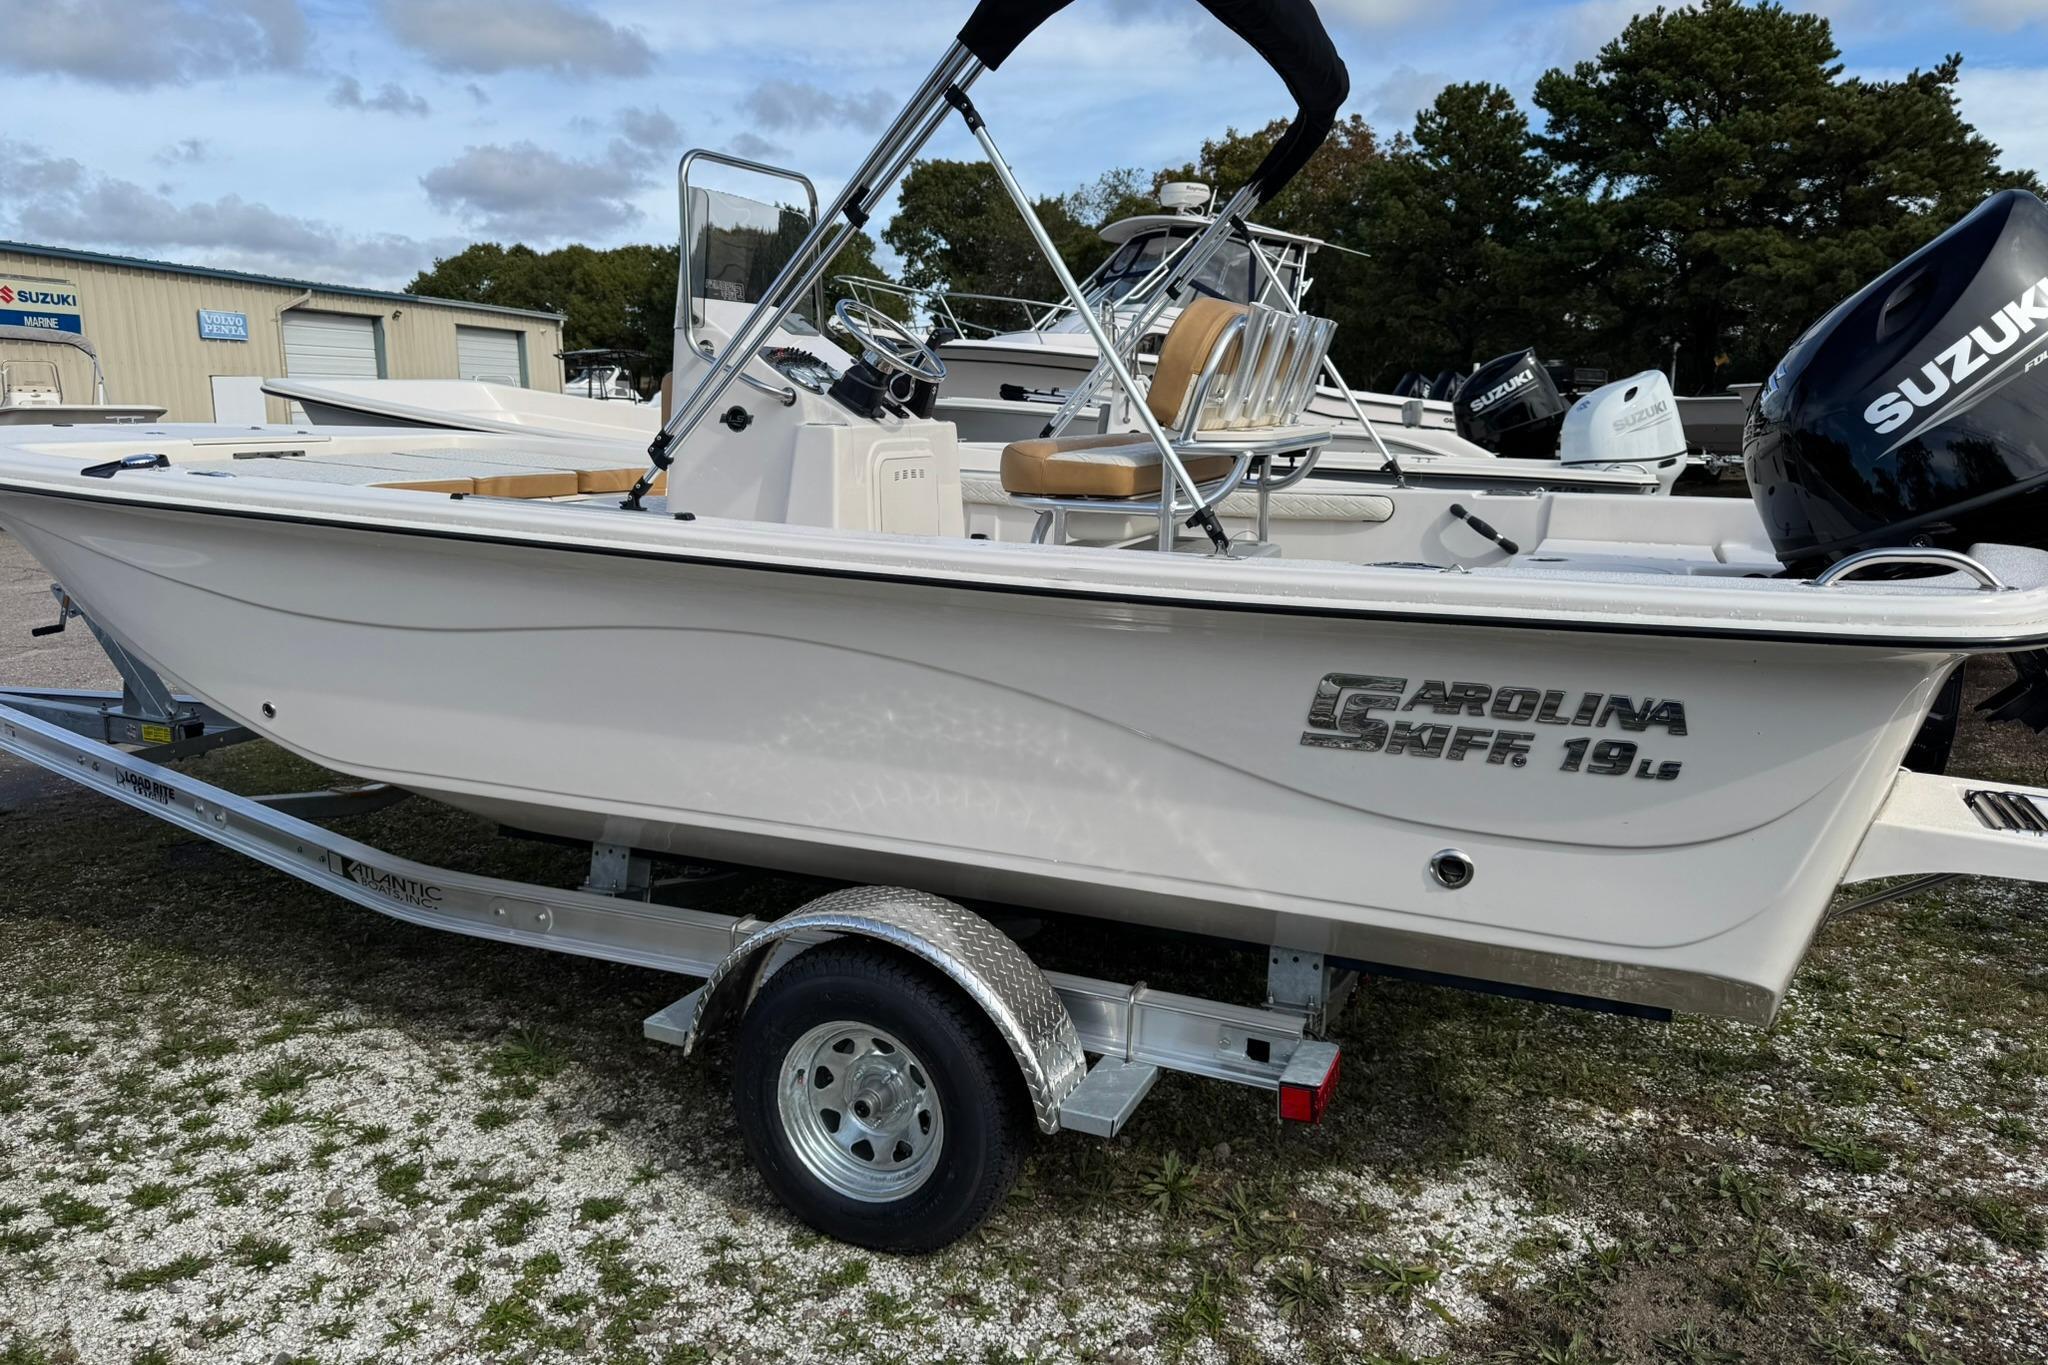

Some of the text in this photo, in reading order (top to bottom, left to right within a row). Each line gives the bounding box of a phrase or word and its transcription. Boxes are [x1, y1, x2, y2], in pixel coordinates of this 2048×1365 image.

[17, 289, 77, 307] SUZUKI
[24, 315, 59, 329] MARINE
[204, 314, 243, 327] VOLVO
[204, 323, 246, 336] PENTA
[1863, 276, 2048, 434] SUZUK
[1470, 368, 1534, 412] SUZUKI
[1612, 400, 1668, 432] SUZUKI
[1308, 672, 1688, 736] CAROLINA
[1559, 736, 1638, 776] 19
[1635, 758, 1682, 781] LS
[124, 770, 152, 790] LOAD
[152, 781, 176, 800] RITE
[351, 861, 443, 901] ATLANTIC
[405, 894, 438, 910] INC.
